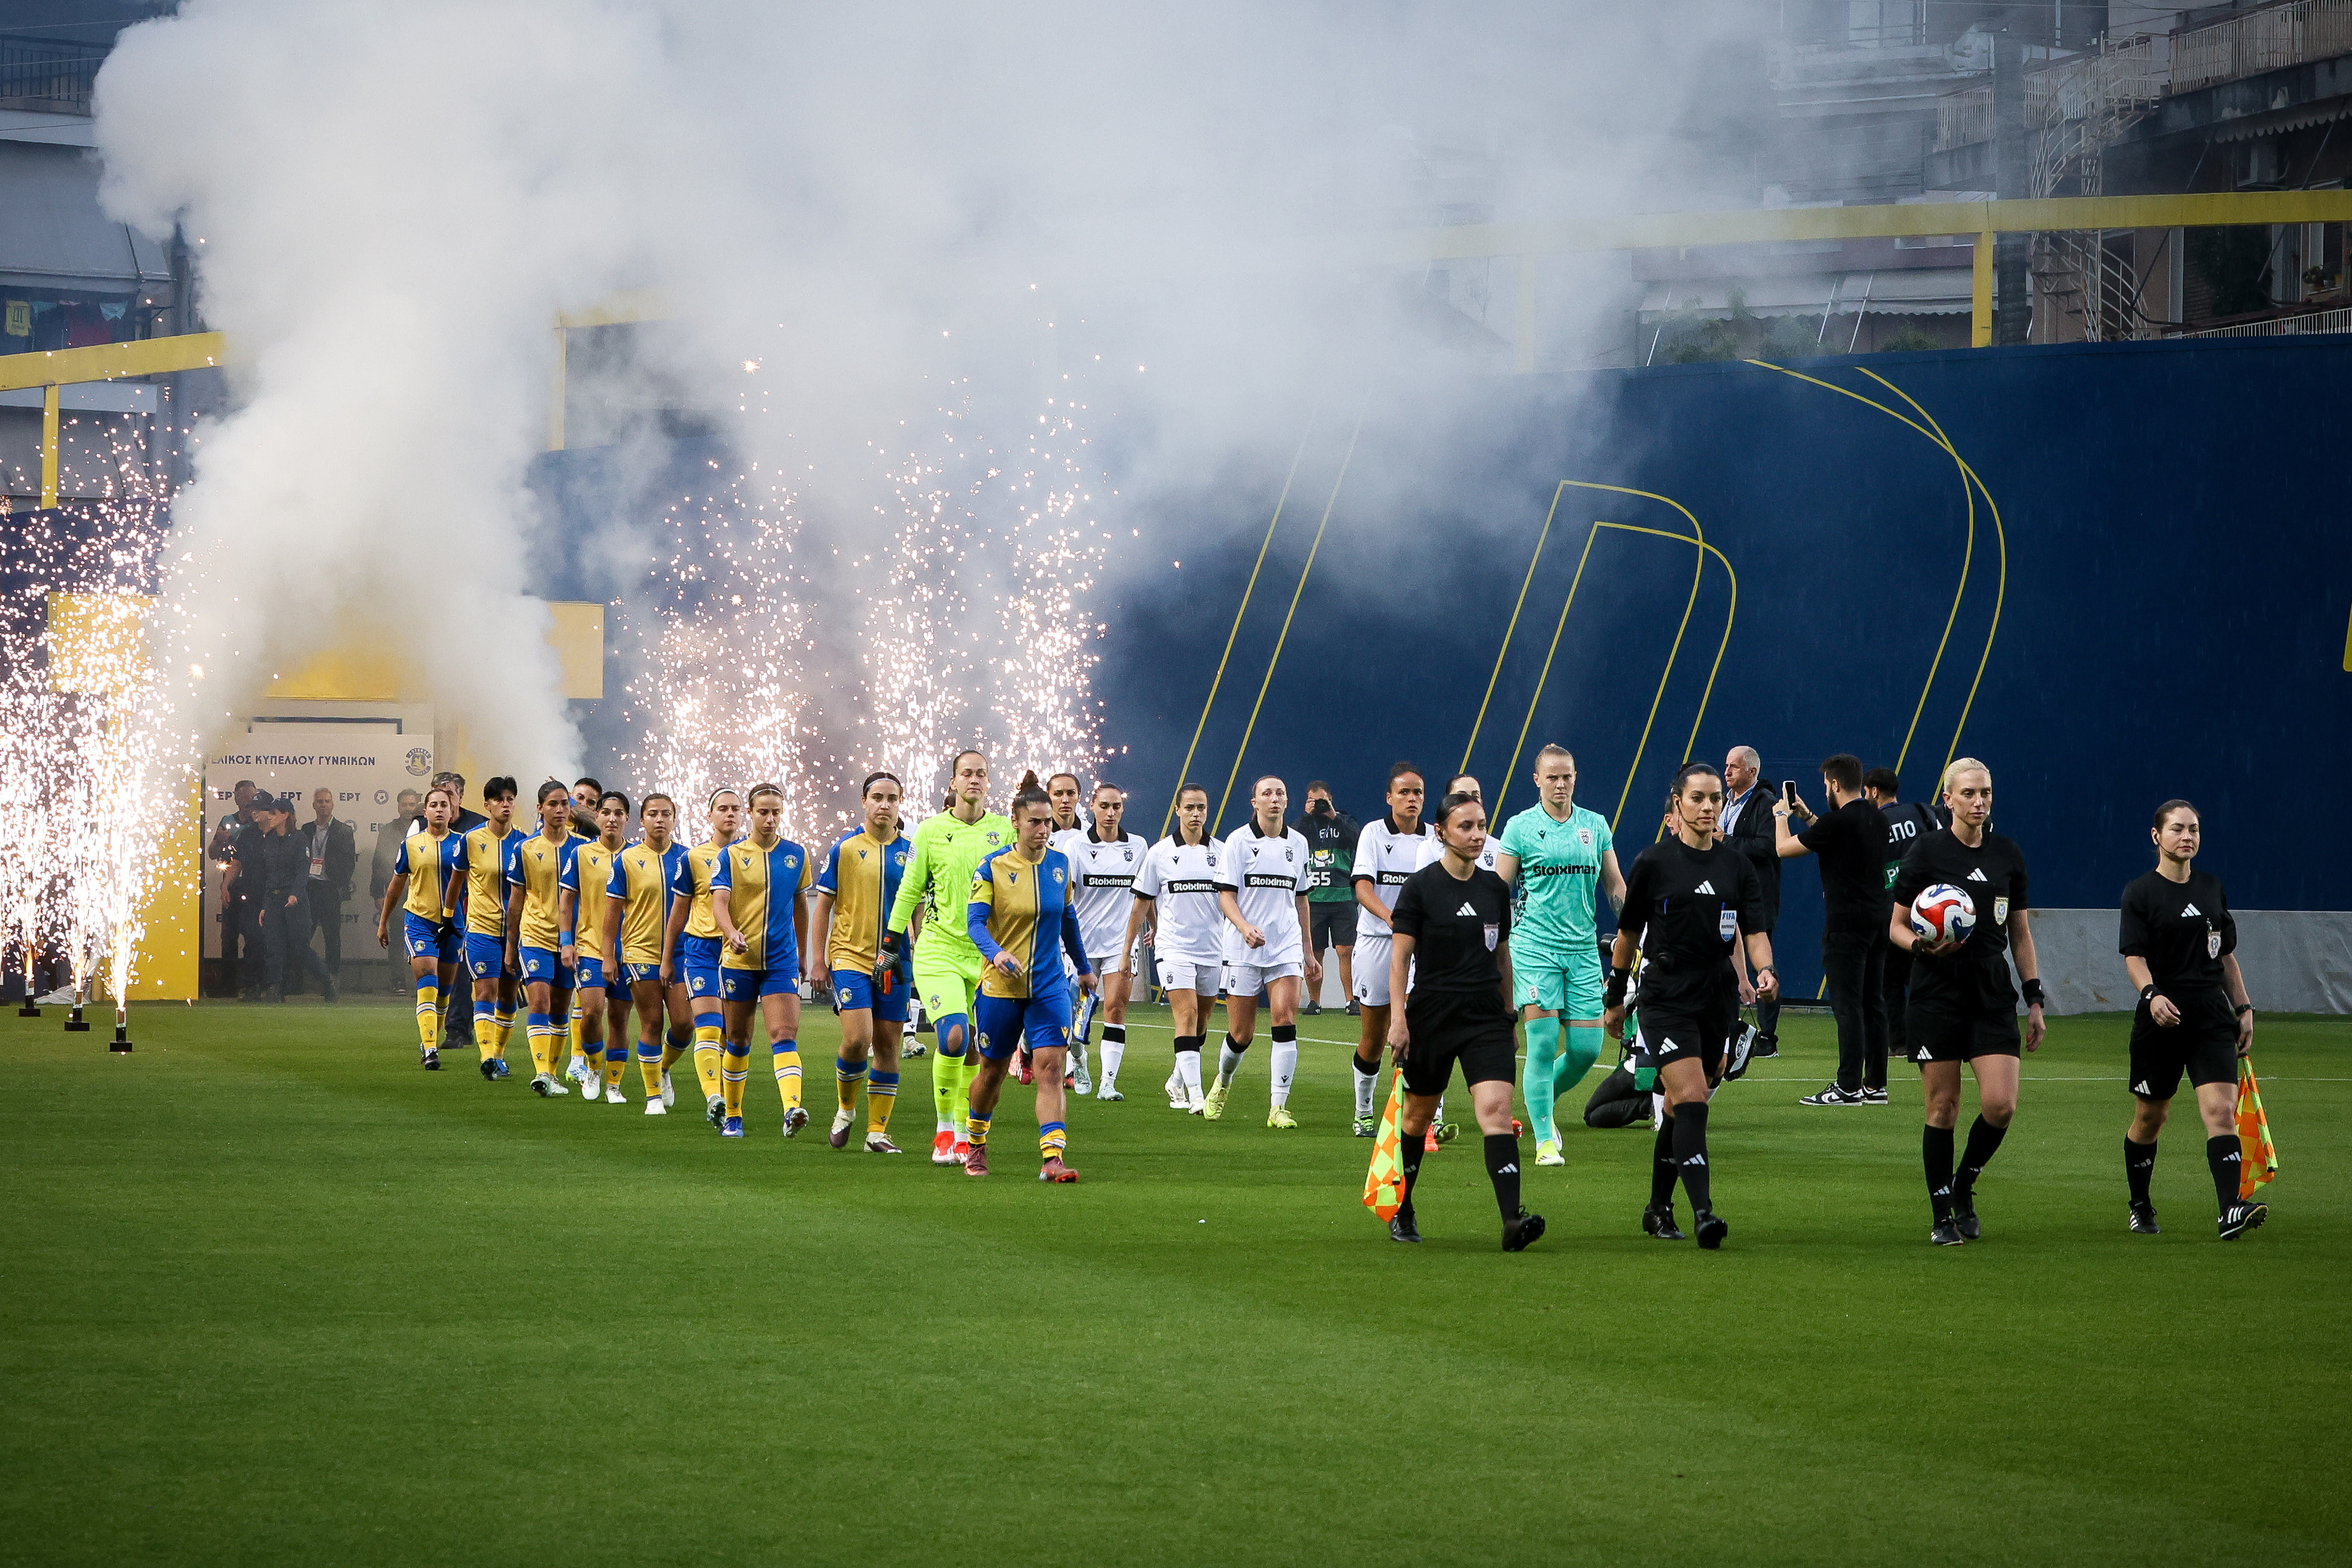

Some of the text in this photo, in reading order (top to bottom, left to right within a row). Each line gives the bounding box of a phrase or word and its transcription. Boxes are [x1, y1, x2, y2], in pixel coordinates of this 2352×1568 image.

[255, 755, 314, 764] ΚΥΠΕΛΛΟΥ
[319, 756, 375, 765] ΓΥΝΑΙΚΩΝ
[218, 792, 235, 800] ΕΡ
[339, 793, 360, 801] ΕΡΤ
[1533, 863, 1595, 877] Stoiximan
[1089, 877, 1131, 886] Stoiximan
[1250, 877, 1293, 888] Stoiximan
[1173, 882, 1217, 891] Stoixima
